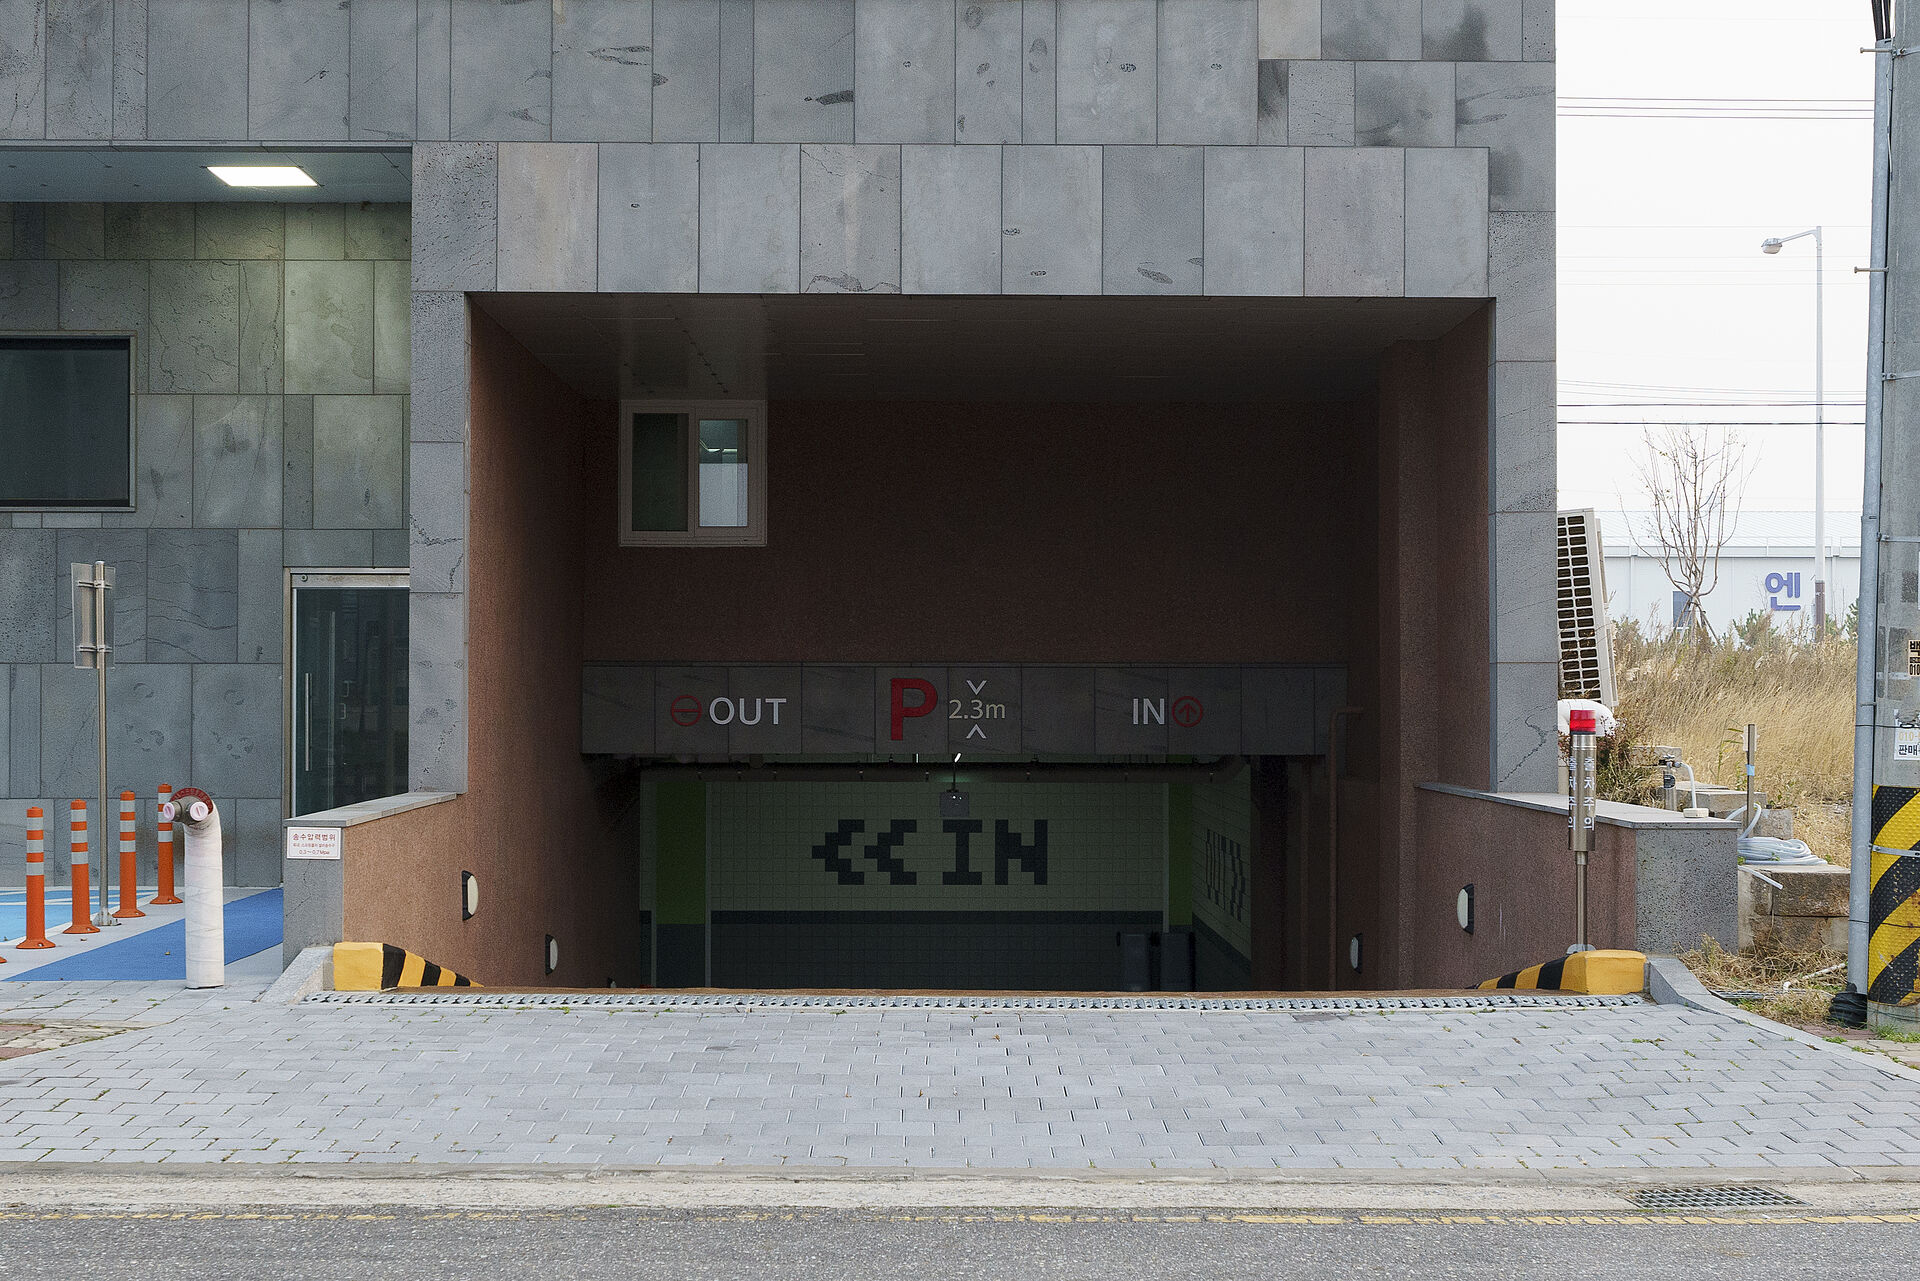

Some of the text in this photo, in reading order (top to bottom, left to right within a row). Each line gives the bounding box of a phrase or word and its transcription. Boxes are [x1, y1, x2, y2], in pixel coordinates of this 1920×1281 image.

[1765, 572, 1801, 611] 엔
[708, 696, 787, 726] OUT
[891, 677, 939, 742] P
[949, 699, 1006, 720] 2.3m
[1132, 697, 1165, 725] IN
[1583, 756, 1595, 832] 출차주의
[942, 819, 1048, 885] IN
